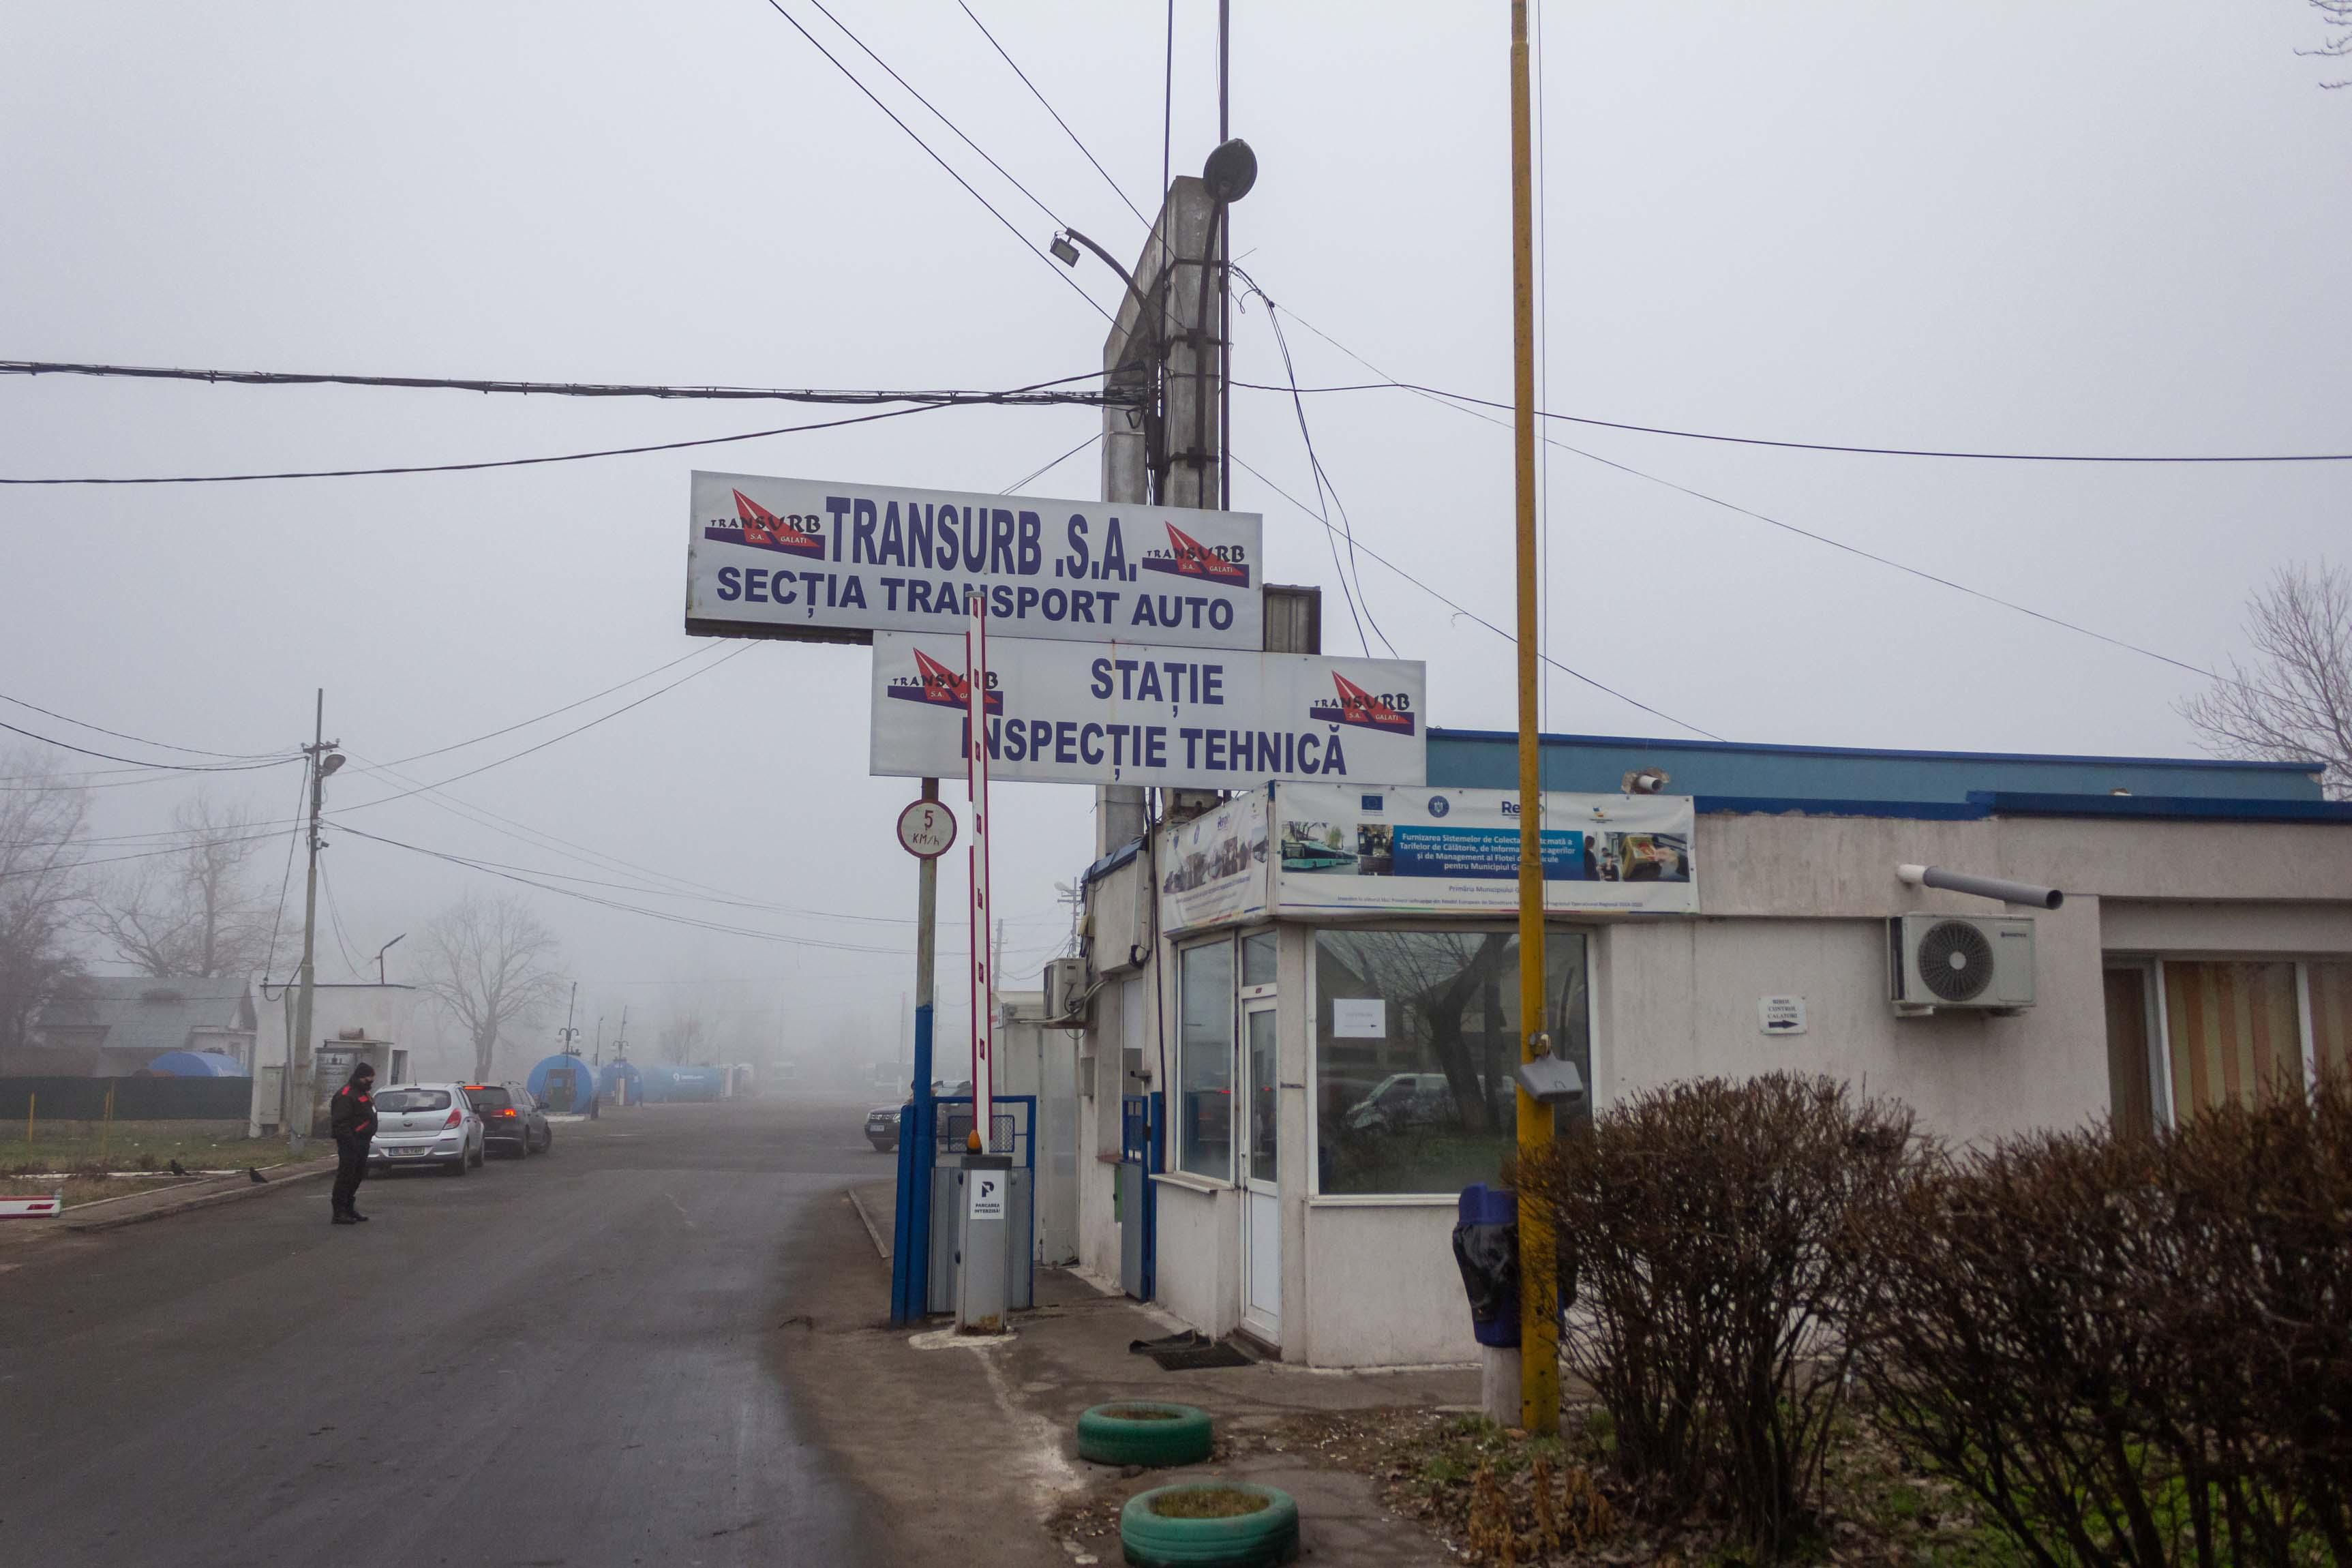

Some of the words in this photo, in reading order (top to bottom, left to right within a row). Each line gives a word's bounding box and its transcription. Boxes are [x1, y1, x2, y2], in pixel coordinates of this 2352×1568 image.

[710, 514, 821, 534] TRANSURB
[826, 496, 1042, 575] TRANSURB
[1147, 545, 1245, 563] TRANSURB
[717, 566, 867, 618] SECȚIA
[880, 577, 1120, 624] TRANSPORT
[1132, 594, 1234, 631] AUTO
[893, 672, 999, 690] TRANSUB
[1091, 658, 1224, 718] STAȚIE
[1314, 693, 1410, 711] TRANSURB
[1180, 724, 1347, 775] TEHNICĂ
[924, 809, 934, 828] 5
[1400, 842, 1430, 850] Tarifelor
[1402, 833, 1441, 841] Furnizarea
[1443, 834, 1481, 843] Sistemelor
[1436, 853, 1485, 862] Management
[1471, 863, 1509, 871] Municipiul
